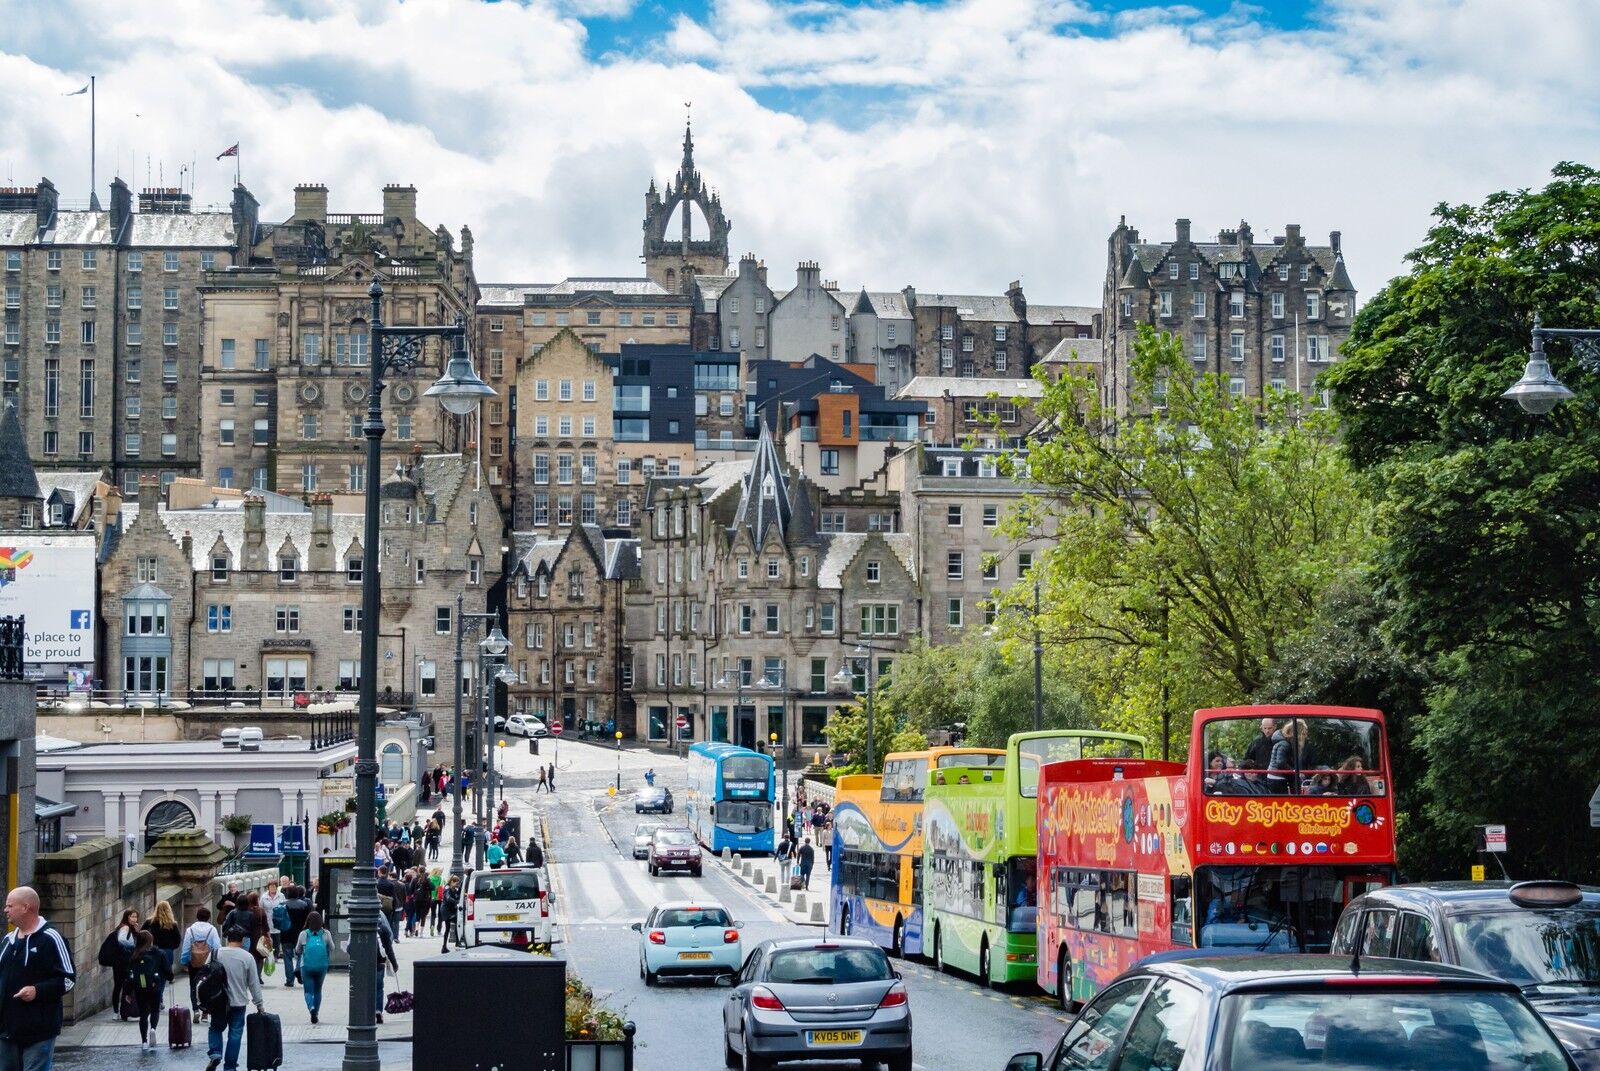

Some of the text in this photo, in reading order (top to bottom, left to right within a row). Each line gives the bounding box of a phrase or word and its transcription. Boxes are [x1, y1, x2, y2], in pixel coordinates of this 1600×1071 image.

[24, 631, 81, 645] A place to
[27, 646, 81, 660] be proud
[1058, 787, 1073, 837] City
[1073, 785, 1122, 844] Sightseeing
[1206, 800, 1243, 825] City
[1245, 800, 1350, 828] Sightseeing
[1298, 823, 1342, 836] Edinburgh
[814, 1031, 858, 1041] KV05 ONF
